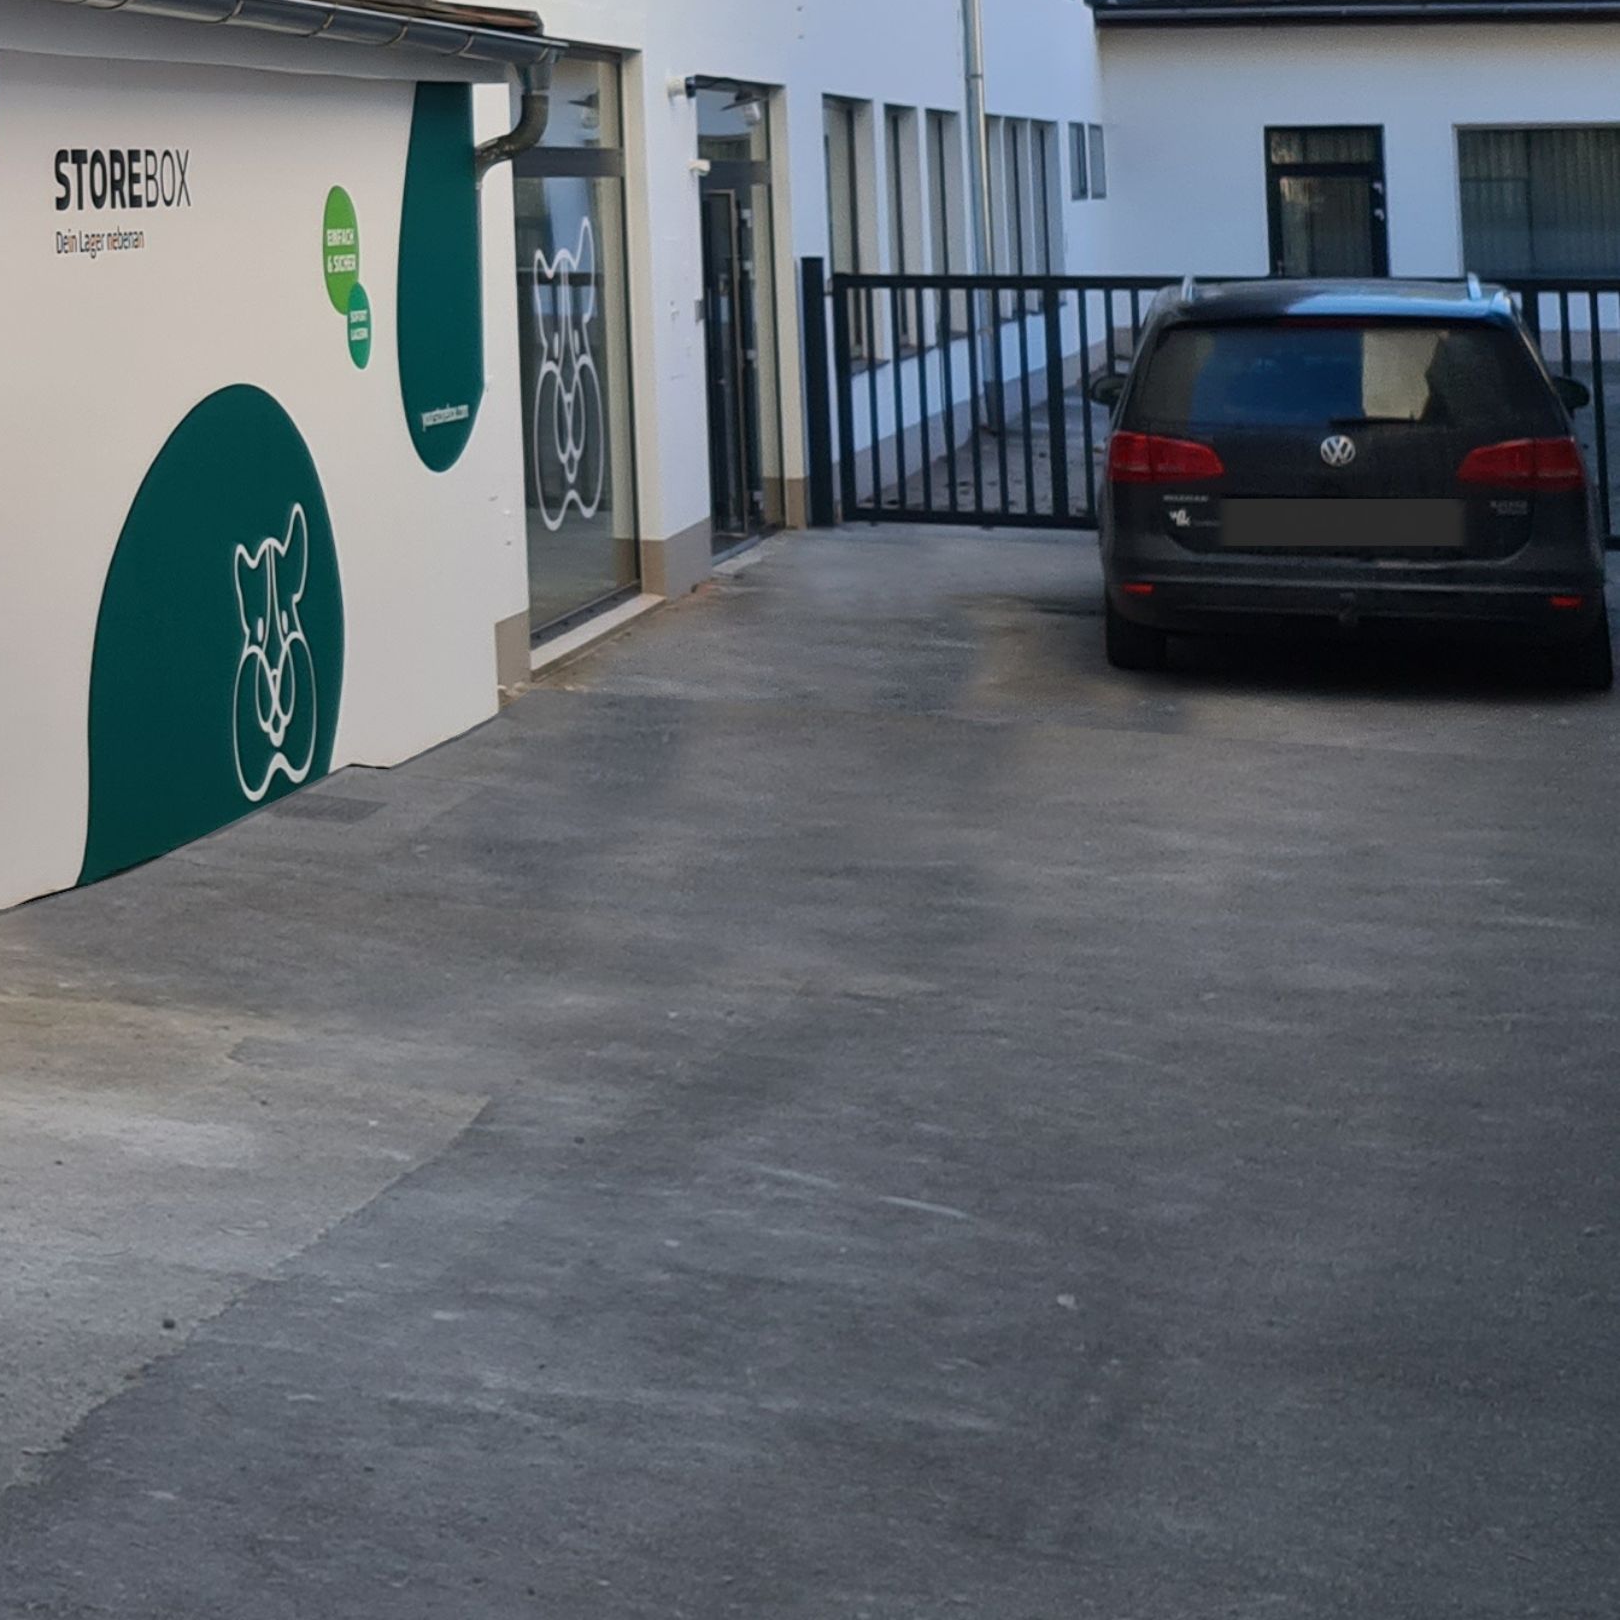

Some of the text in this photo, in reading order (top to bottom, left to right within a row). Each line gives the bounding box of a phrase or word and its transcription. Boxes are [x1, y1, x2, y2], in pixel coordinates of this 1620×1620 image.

[54, 148, 191, 211] STOREBOX
[56, 226, 144, 259] Dein Lager nebenan
